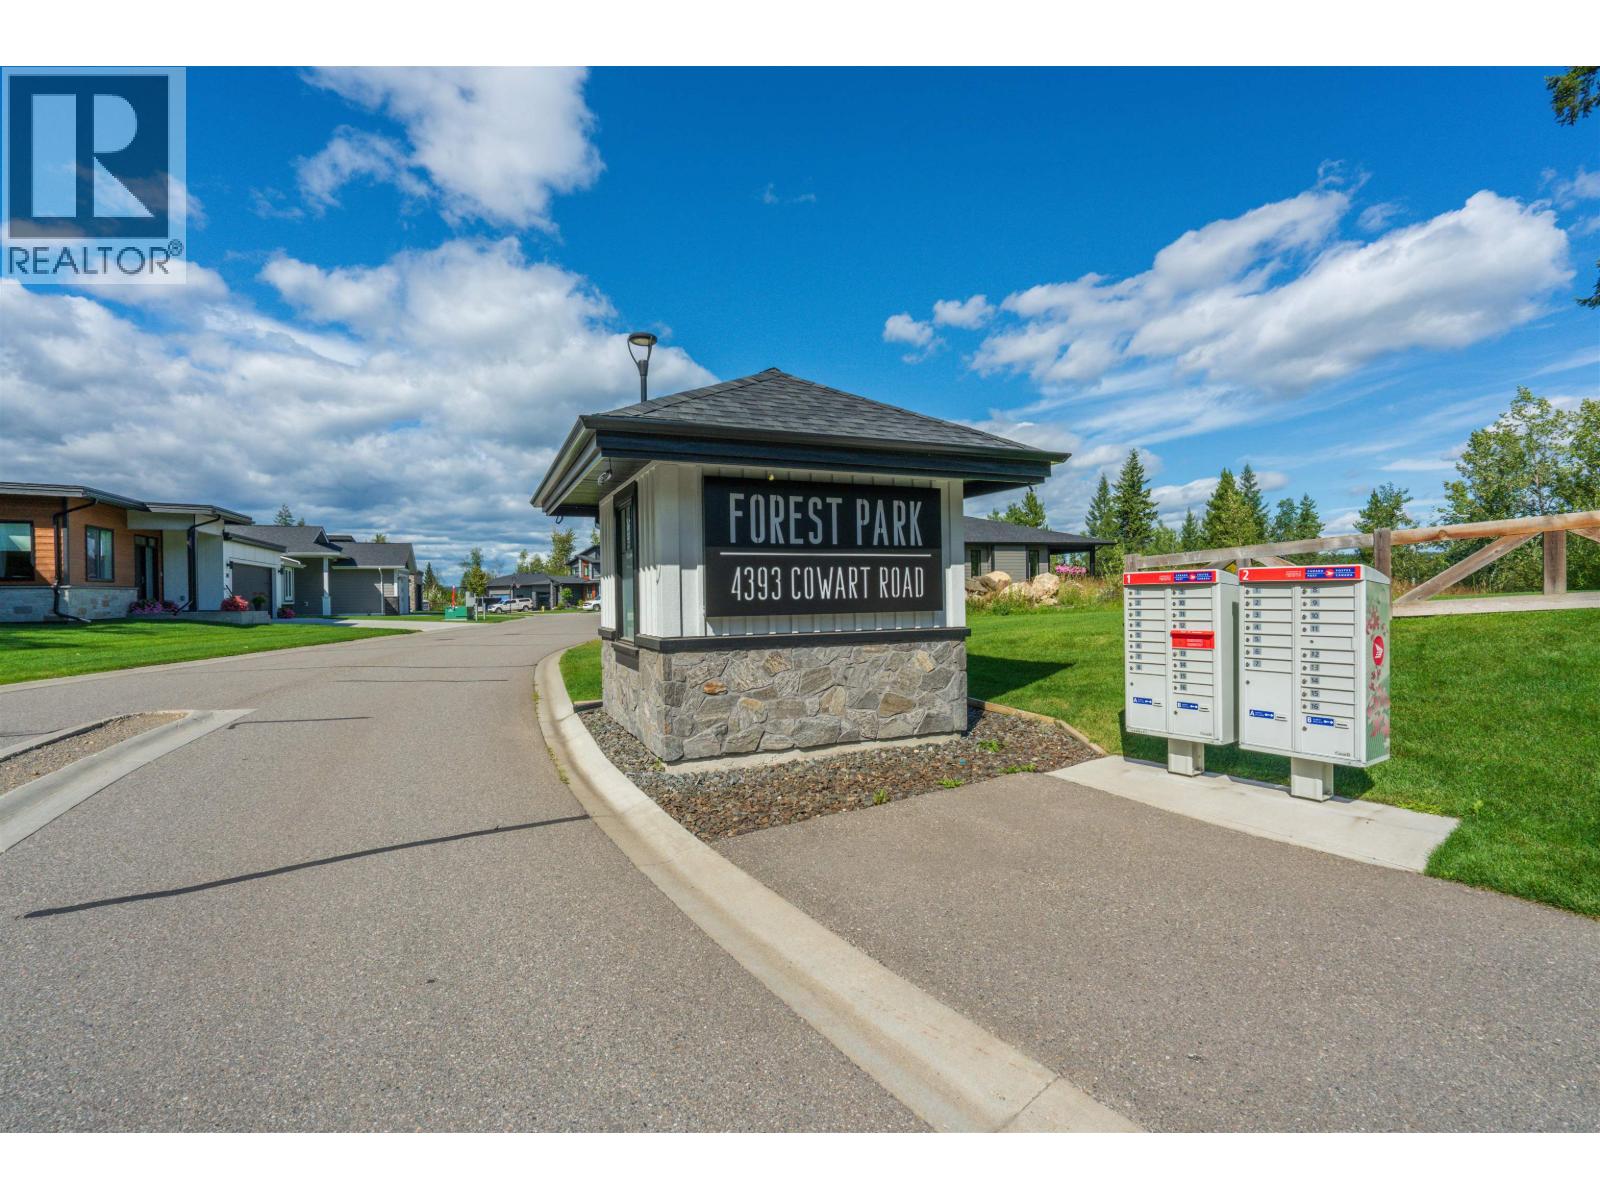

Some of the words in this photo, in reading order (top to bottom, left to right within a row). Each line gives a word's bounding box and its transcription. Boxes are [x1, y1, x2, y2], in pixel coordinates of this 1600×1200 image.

[729, 492, 843, 545] FOREST
[856, 498, 923, 546] PARK
[731, 566, 782, 601] 4393
[791, 566, 871, 600] COWART
[879, 567, 924, 599] ROAD
[1126, 575, 1131, 583] 1
[1242, 570, 1249, 580] 2
